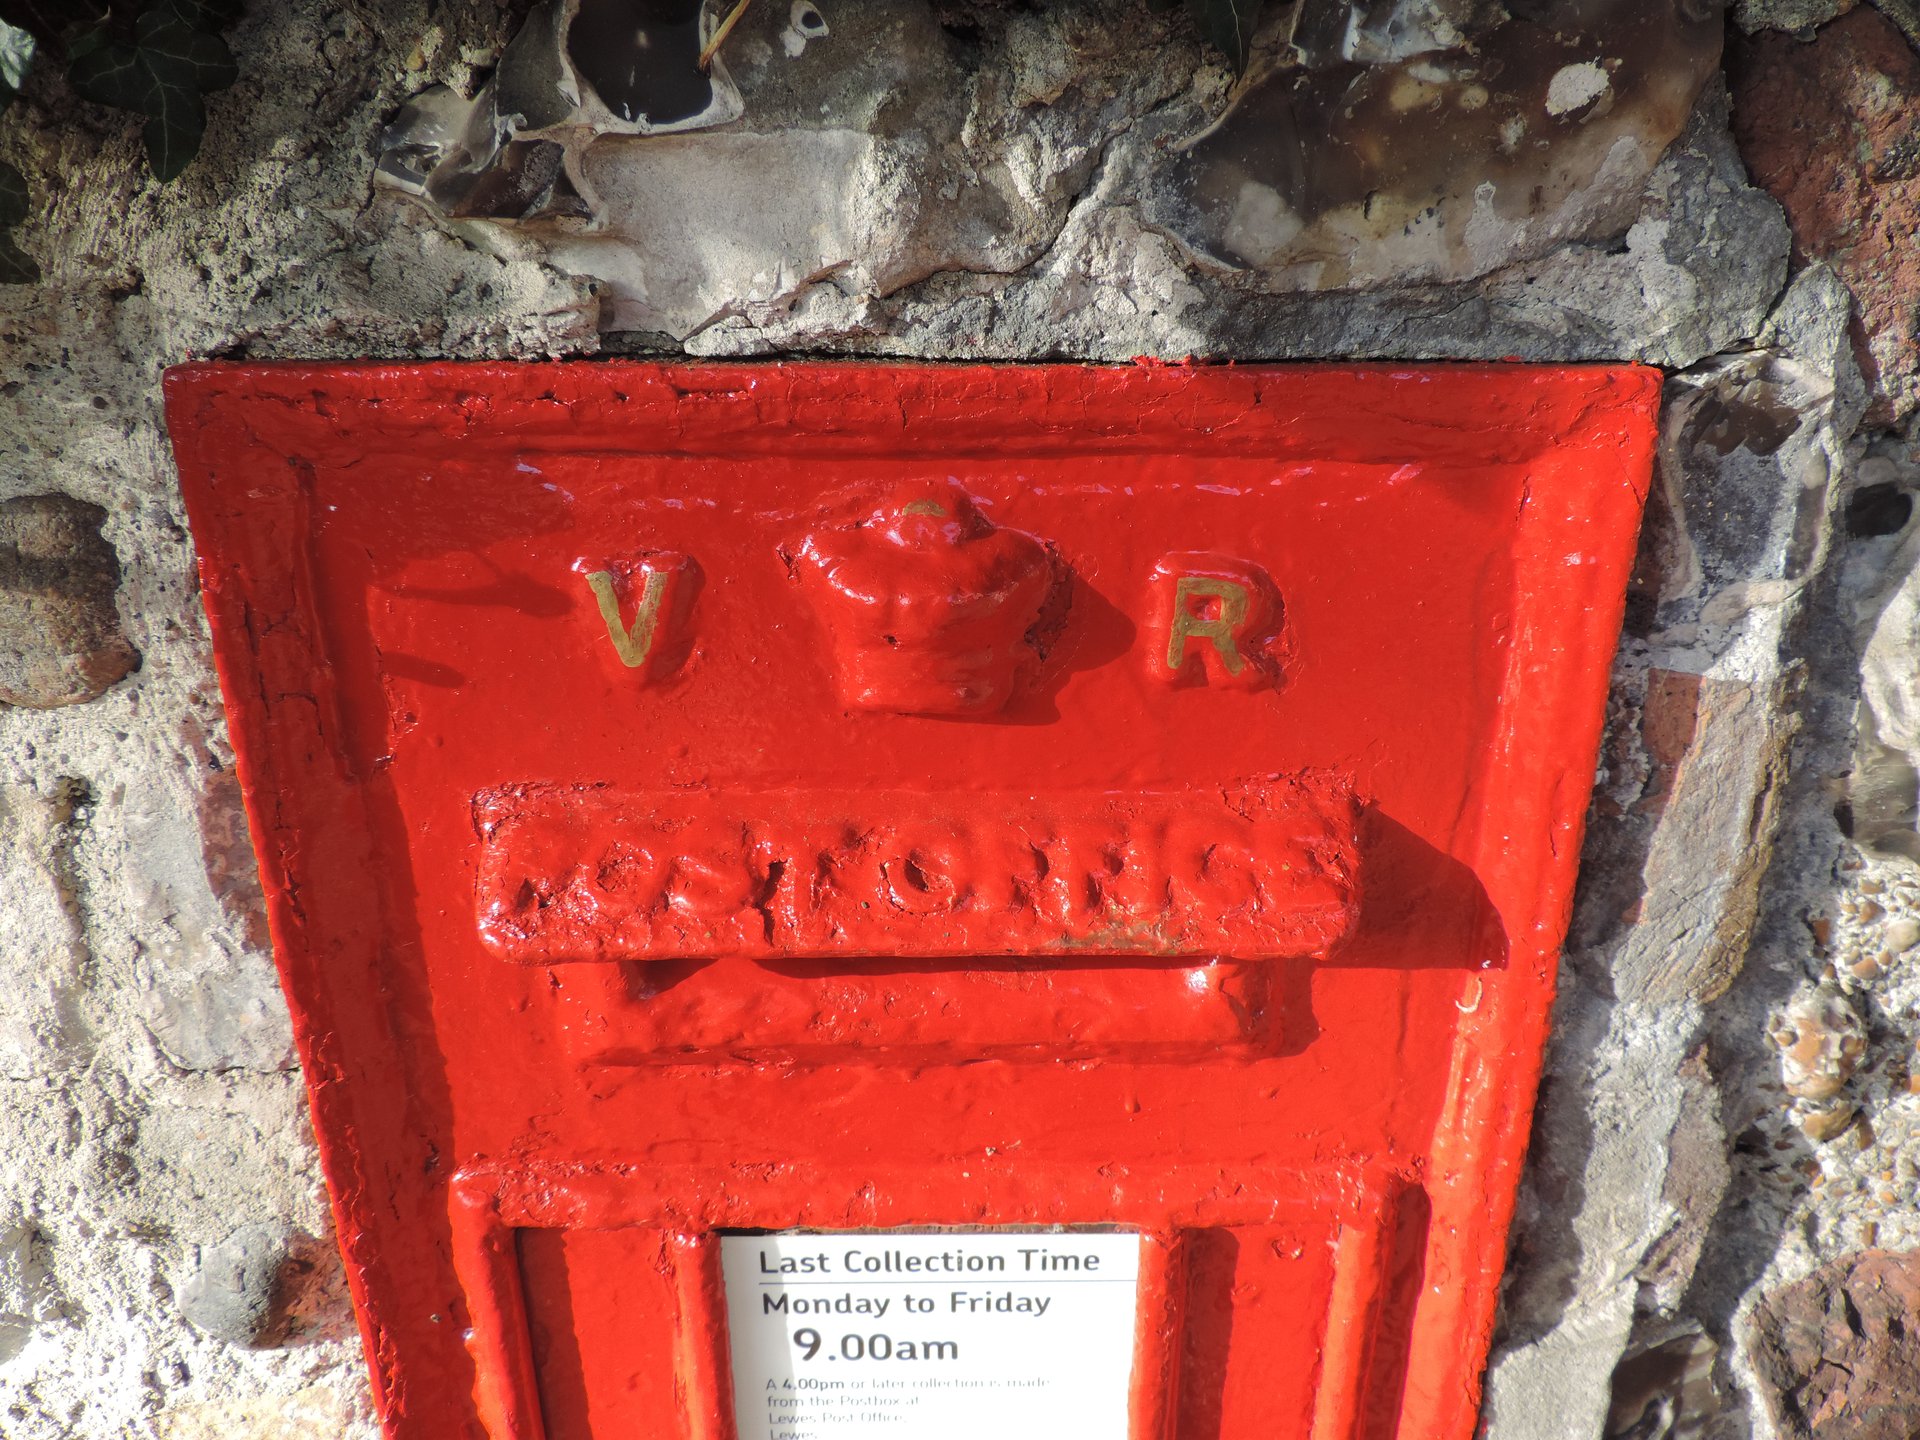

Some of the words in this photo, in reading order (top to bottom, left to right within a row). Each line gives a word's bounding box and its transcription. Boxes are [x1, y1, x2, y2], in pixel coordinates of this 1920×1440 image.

[578, 562, 676, 672] V
[1160, 565, 1265, 682] R
[759, 1250, 832, 1274] Last
[843, 1249, 1006, 1273] Collection
[1016, 1248, 1101, 1272] Time
[762, 1292, 891, 1319] Monday
[903, 1294, 936, 1314] to
[950, 1290, 1052, 1318] Friday
[792, 1327, 959, 1362] 9.00am
[766, 1379, 777, 1391] A
[782, 1378, 845, 1392] 4.00pm
[851, 1380, 865, 1389] or
[872, 1378, 905, 1389] later
[912, 1377, 983, 1388] collection
[1007, 1377, 1050, 1388] made
[767, 1395, 804, 1408] from
[810, 1395, 834, 1407] the
[840, 1395, 899, 1406] Postbox
[906, 1396, 919, 1406] at
[769, 1412, 817, 1425] Lewes
[823, 1412, 854, 1424] Post
